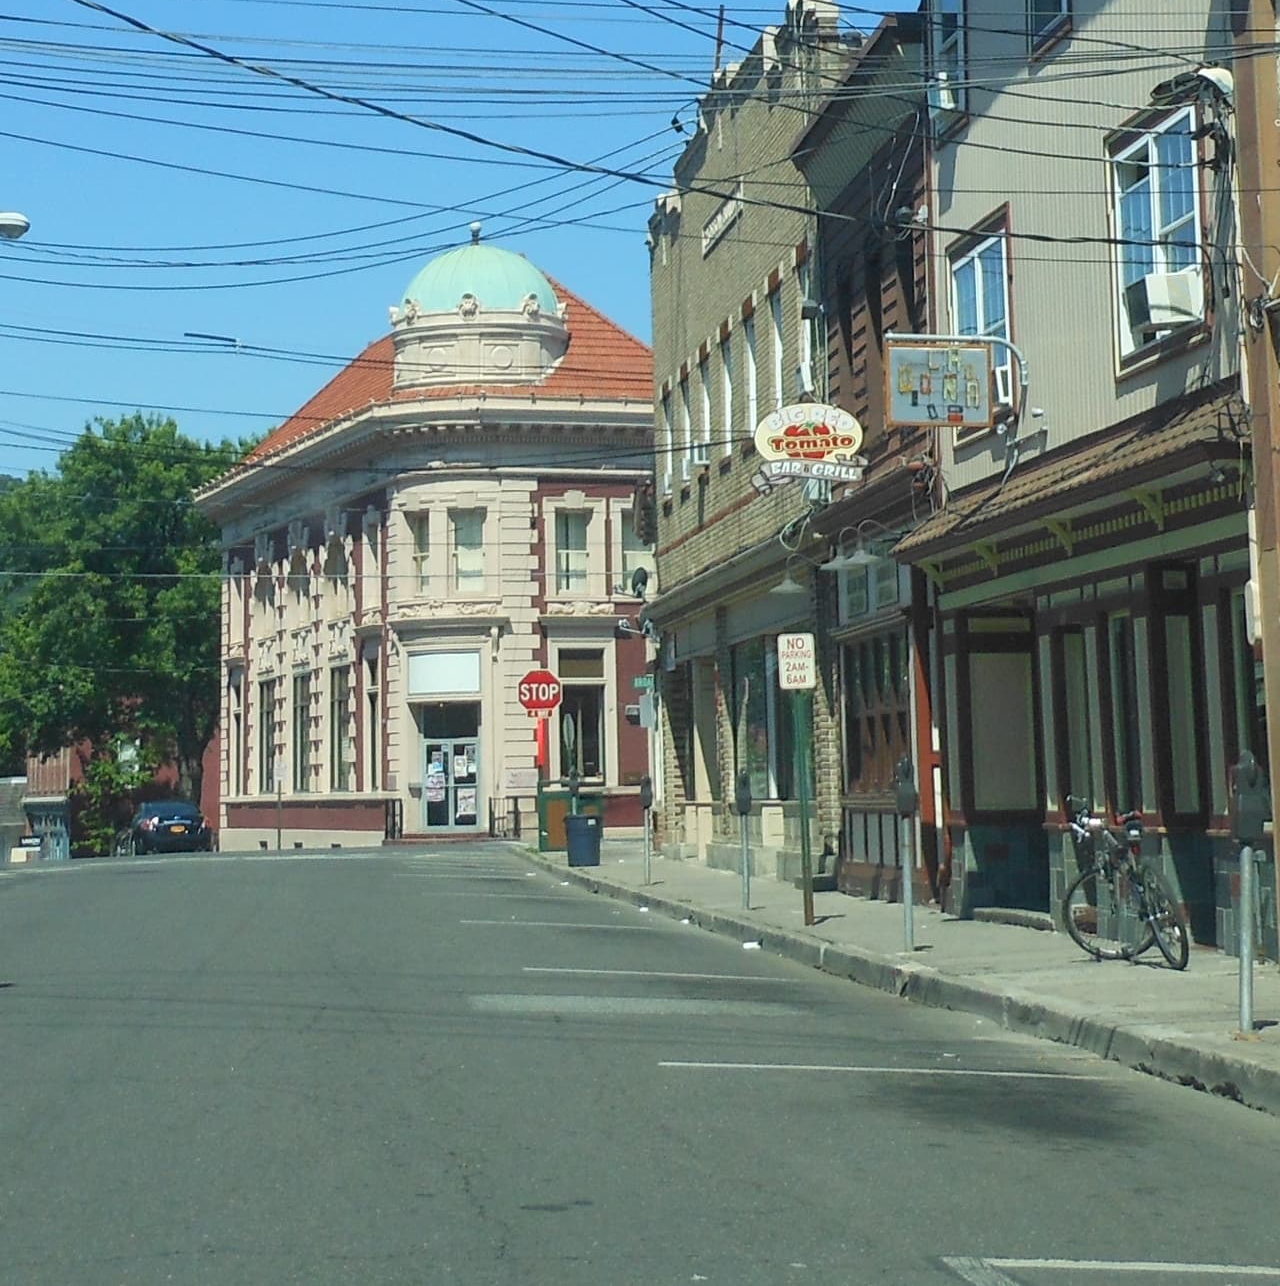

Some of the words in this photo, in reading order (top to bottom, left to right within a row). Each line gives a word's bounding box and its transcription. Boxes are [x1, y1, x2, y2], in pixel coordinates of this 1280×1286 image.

[766, 406, 806, 431] BIG
[809, 406, 855, 431] RED
[769, 434, 855, 452] Tomato
[770, 461, 801, 475] BAR
[811, 463, 858, 480] GRILL
[786, 637, 805, 650] NO
[781, 650, 812, 659] PARKING
[786, 673, 807, 684] 6AM
[520, 683, 559, 701] STOP
